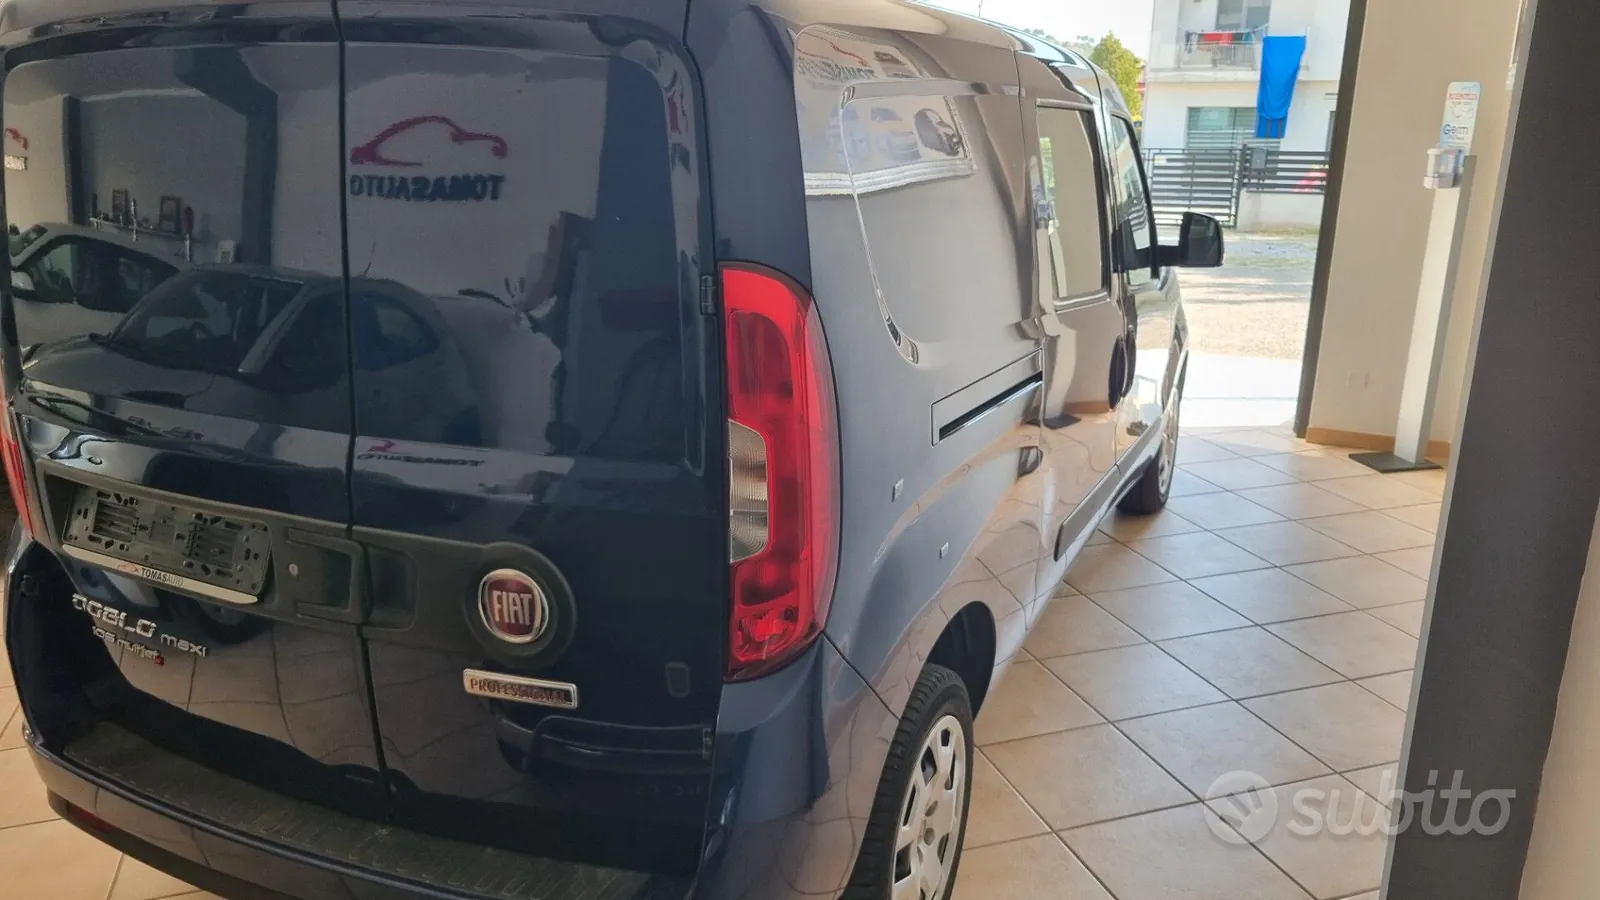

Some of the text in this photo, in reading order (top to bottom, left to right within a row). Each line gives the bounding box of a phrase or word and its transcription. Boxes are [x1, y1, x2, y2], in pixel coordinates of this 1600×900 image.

[141, 567, 184, 587] TOMASAUTO
[492, 590, 532, 625] FIAT
[469, 678, 566, 704] PROFESSIONAL
